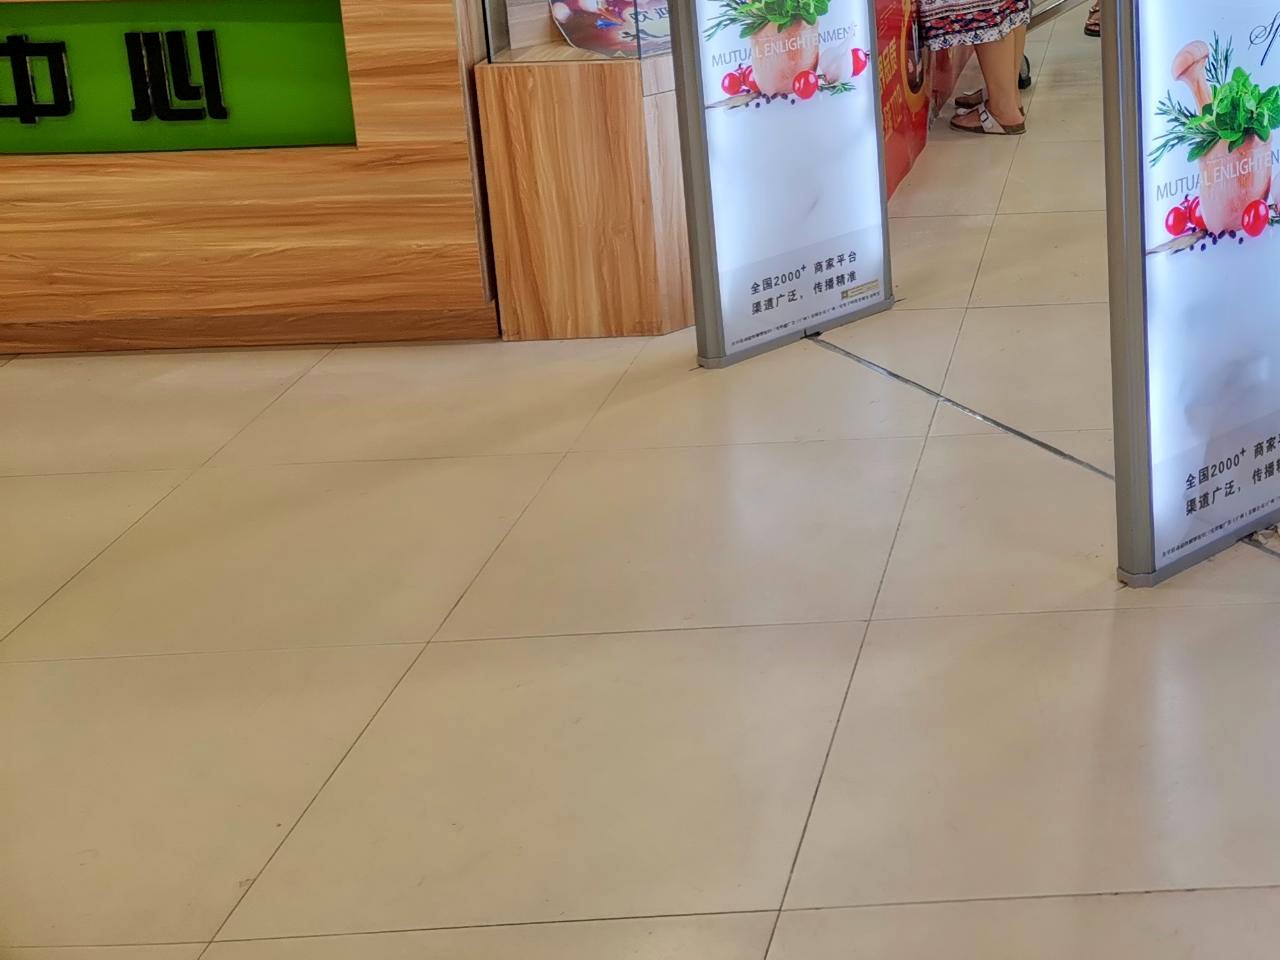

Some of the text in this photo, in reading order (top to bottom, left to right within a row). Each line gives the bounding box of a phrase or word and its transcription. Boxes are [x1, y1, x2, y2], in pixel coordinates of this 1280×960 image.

[711, 43, 762, 68] MUTUAL
[0, 30, 229, 125] 中心
[1155, 166, 1212, 202] MUTUAL
[813, 250, 858, 275] 商家平台
[813, 270, 858, 295] 传播精准
